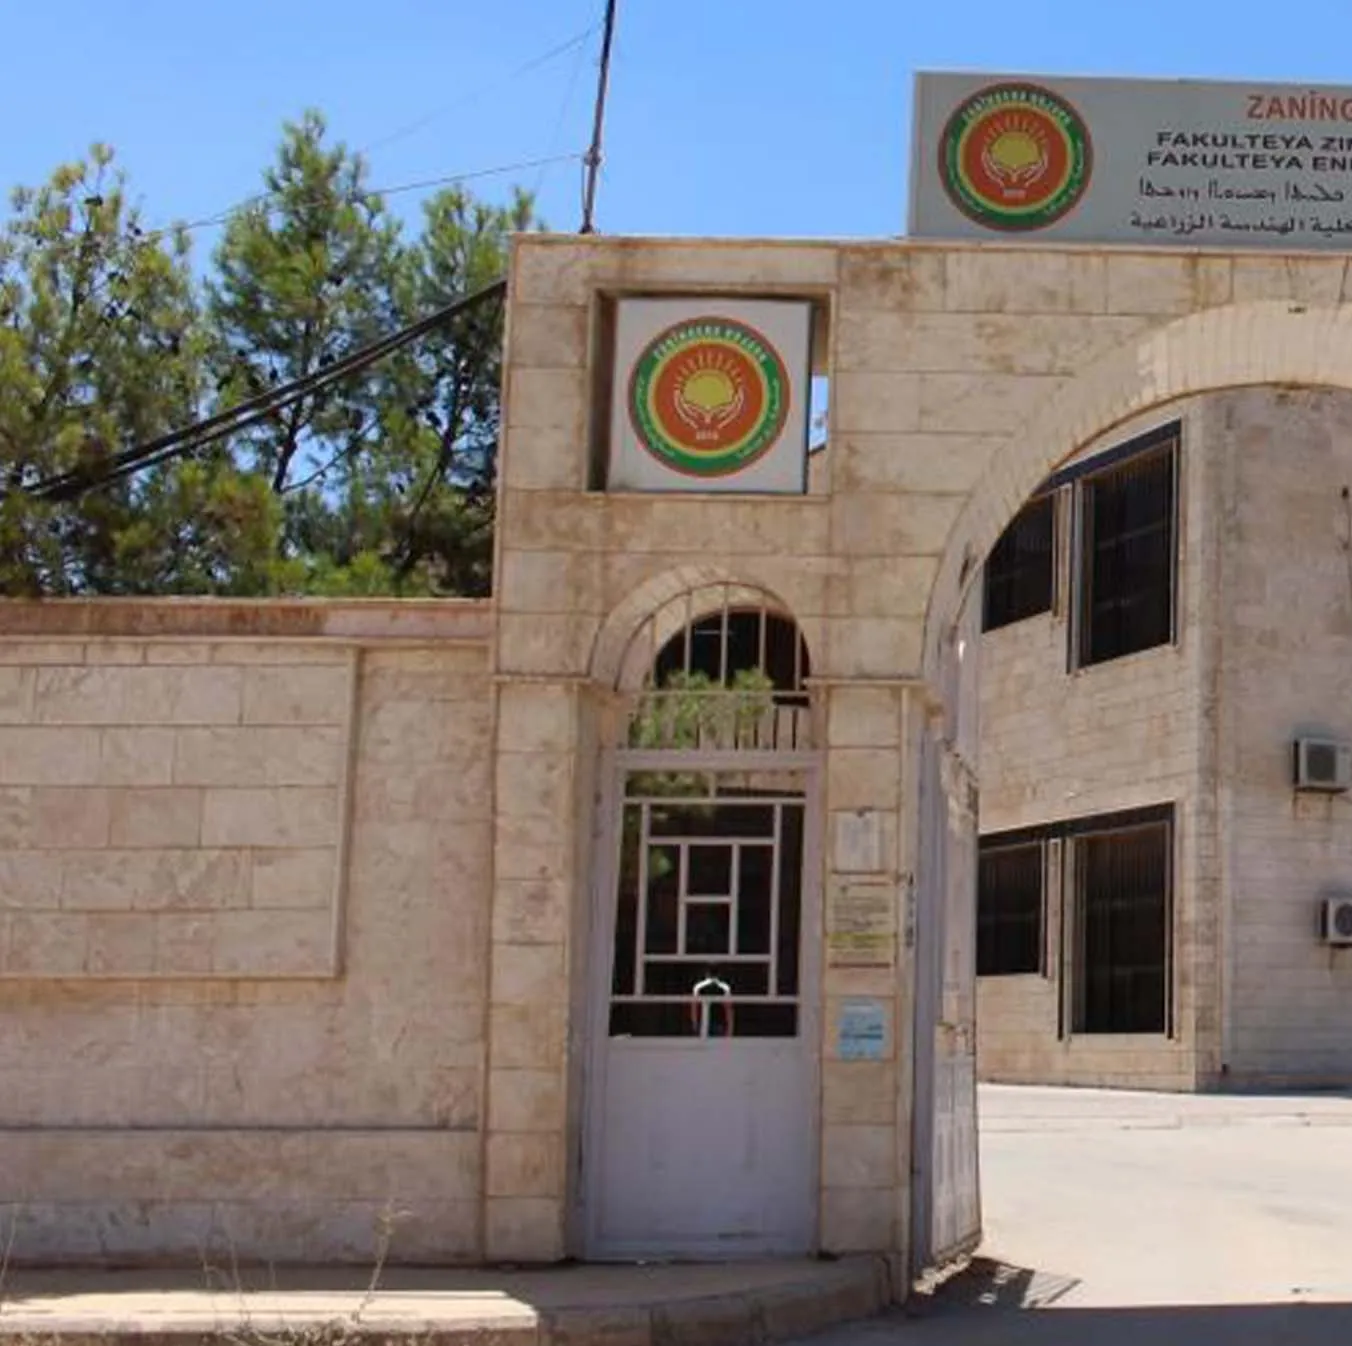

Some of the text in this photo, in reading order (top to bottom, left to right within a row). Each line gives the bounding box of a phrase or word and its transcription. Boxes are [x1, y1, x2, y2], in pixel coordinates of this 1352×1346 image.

[1156, 131, 1313, 151] FAKULTEYA
[1147, 150, 1304, 170] FAKULTEYA
[1130, 213, 1214, 236] الزراعية
[1220, 213, 1305, 236] الهندسة
